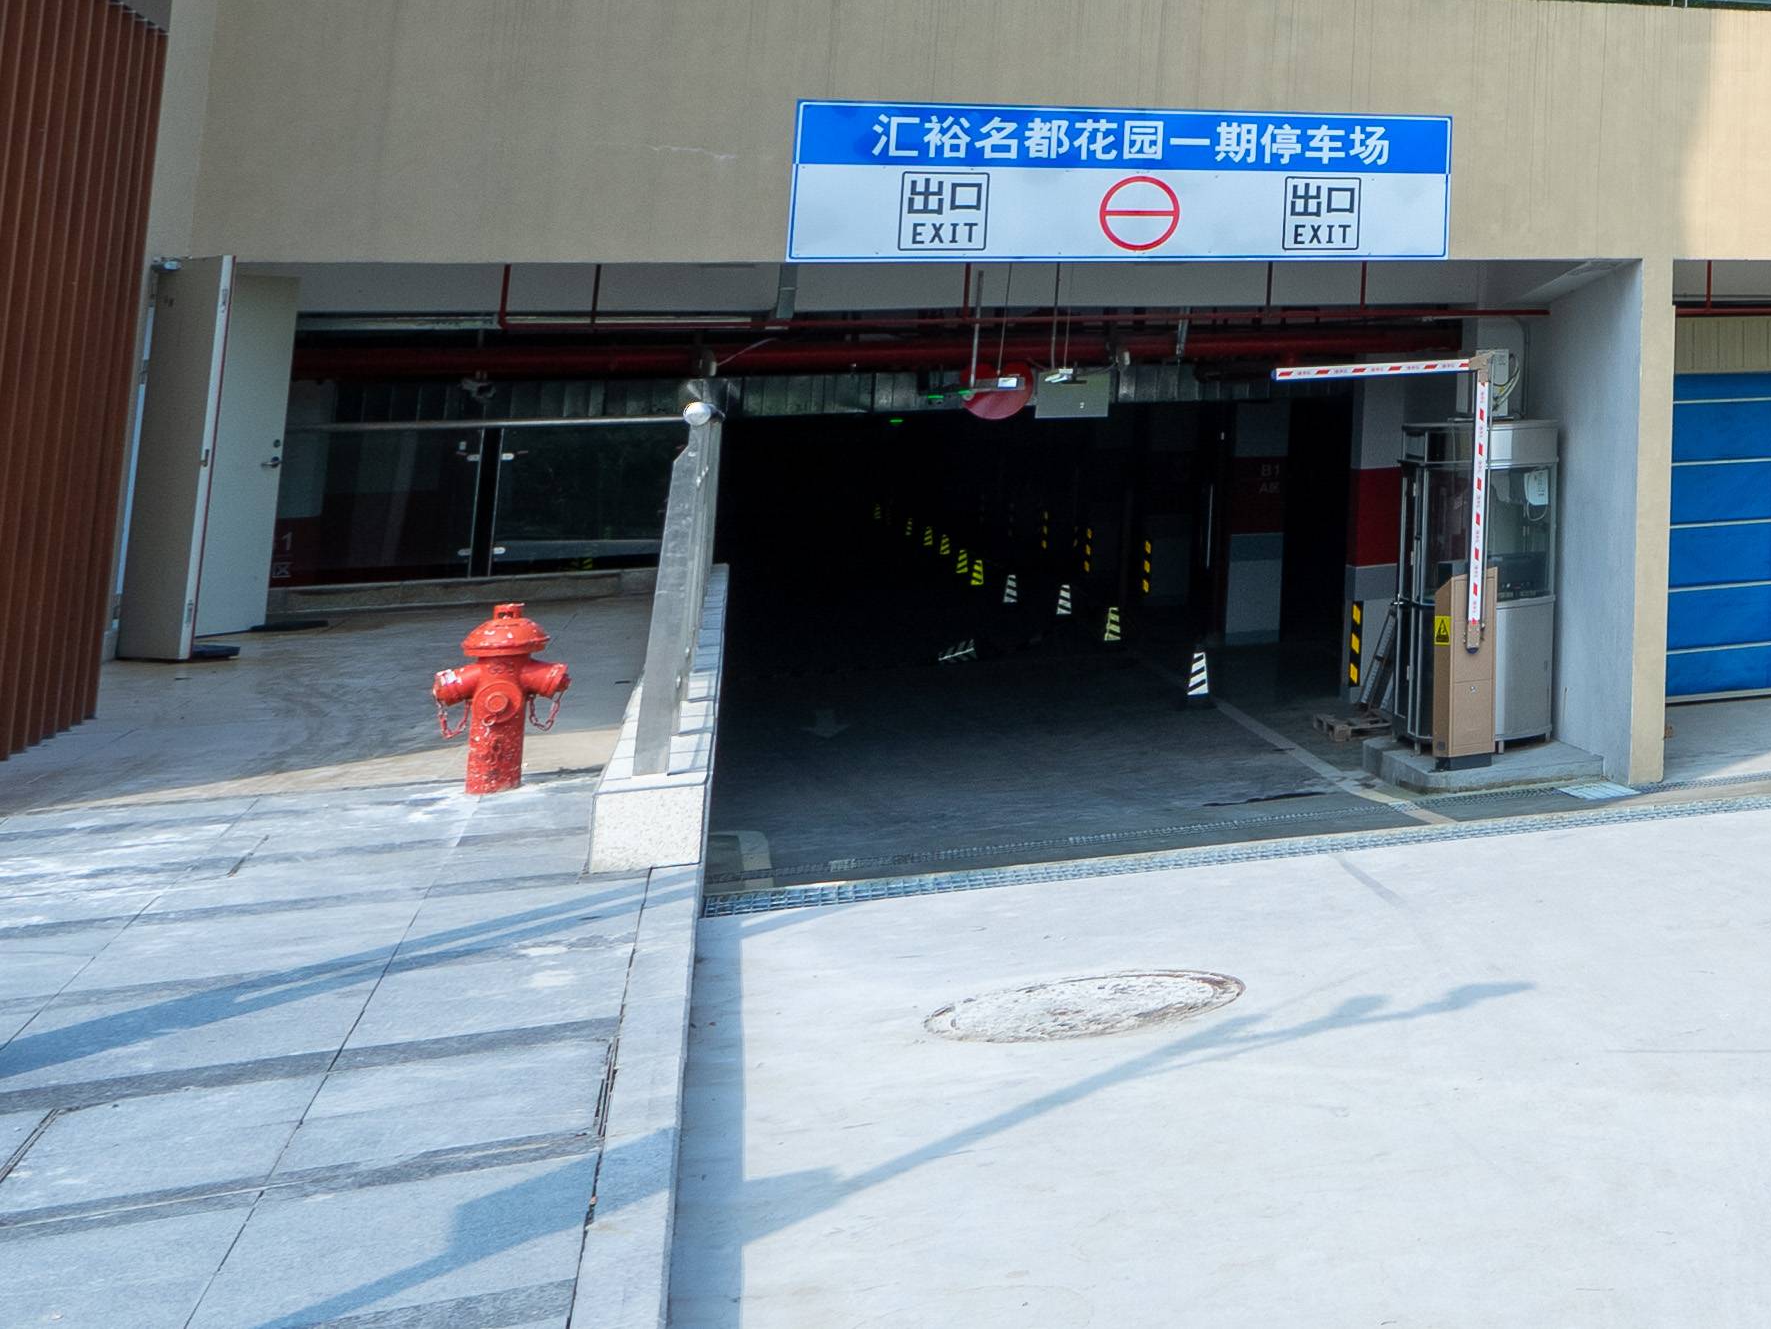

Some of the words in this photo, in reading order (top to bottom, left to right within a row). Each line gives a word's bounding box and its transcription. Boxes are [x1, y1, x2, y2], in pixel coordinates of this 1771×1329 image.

[871, 113, 1390, 165] 汇裕名都花园一期停车场
[907, 178, 983, 215] 出口
[1290, 184, 1356, 217] 出口
[910, 222, 978, 245] EXIT
[1294, 225, 1352, 245] EXIT
[1261, 464, 1280, 479] B1
